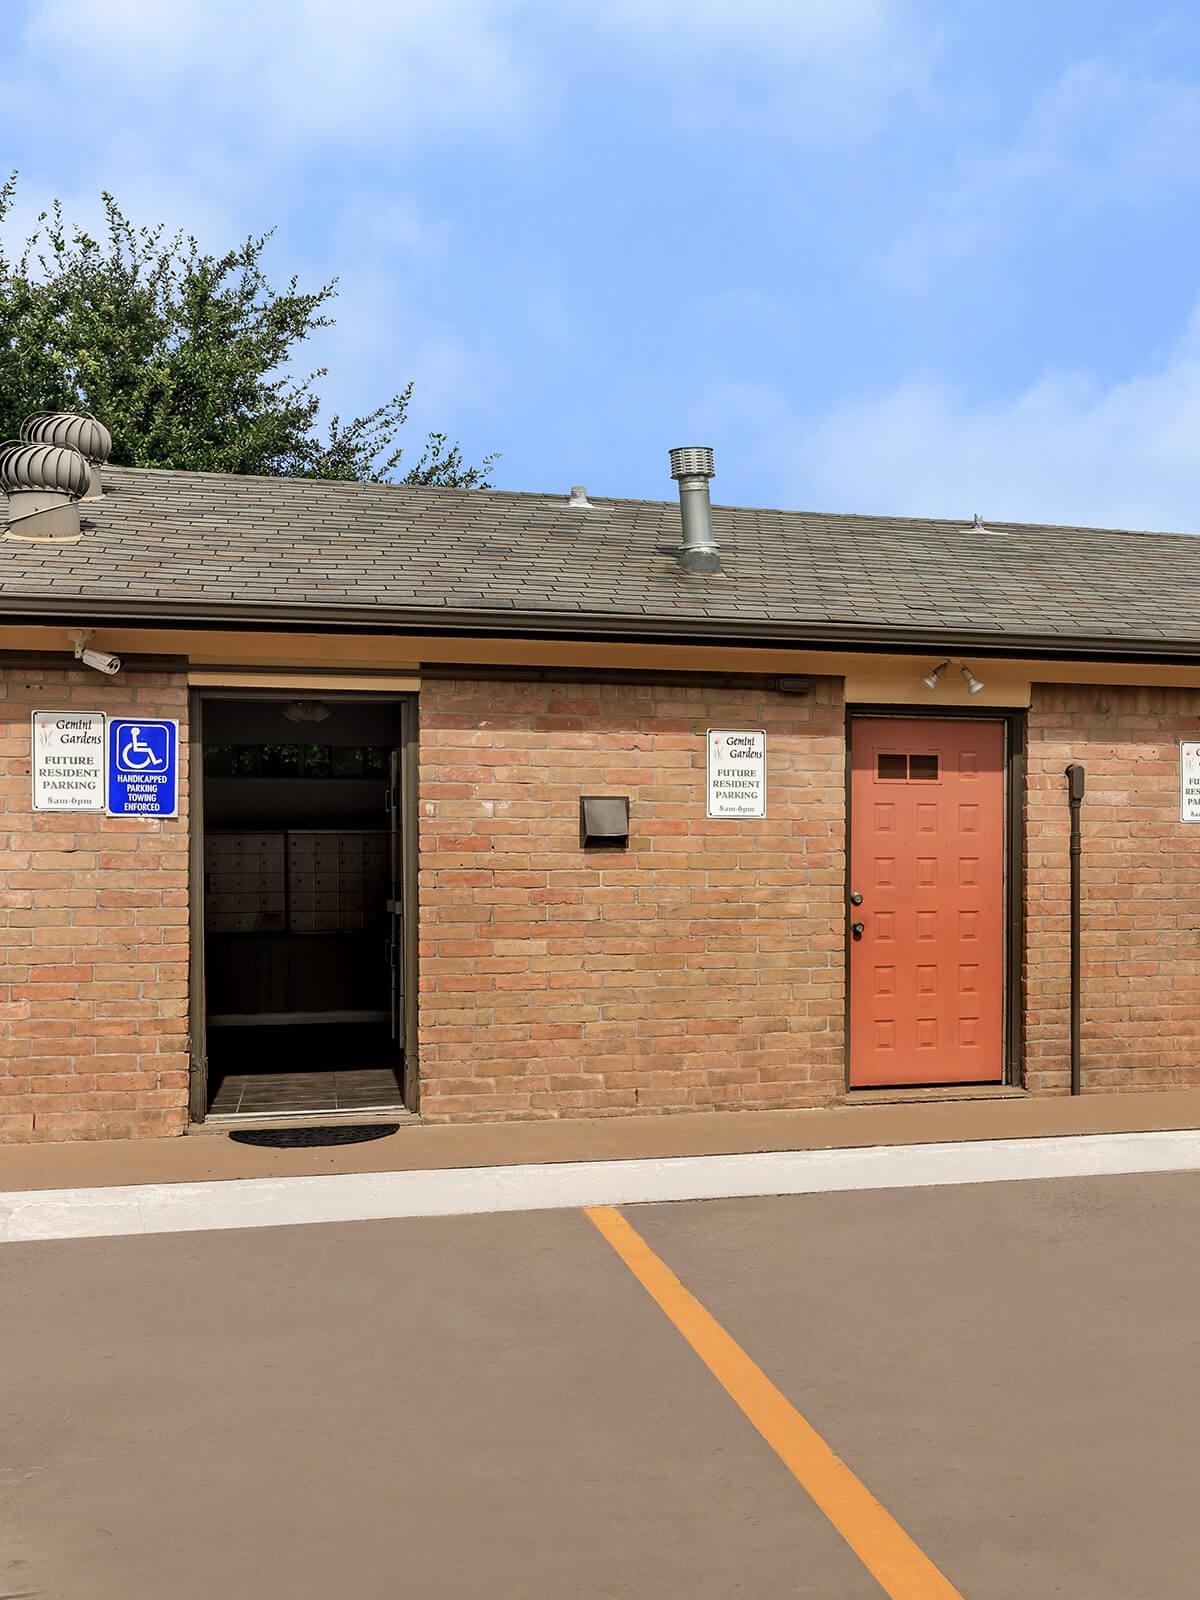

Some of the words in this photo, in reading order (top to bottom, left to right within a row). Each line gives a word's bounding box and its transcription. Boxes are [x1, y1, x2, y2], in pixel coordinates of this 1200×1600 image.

[56, 719, 92, 730] Gemini
[60, 731, 102, 745] Gardens
[726, 736, 755, 746] Gemini
[729, 747, 763, 759] Gardens
[44, 756, 95, 766] FUTURE
[39, 768, 100, 778] RESIDENT
[717, 769, 757, 778] FUTURE
[117, 774, 168, 784] HANDICAPPED
[42, 781, 97, 790] PARKING
[127, 784, 158, 793] PARKING
[712, 780, 761, 789] RESIDENT
[128, 793, 157, 802] TOWING
[715, 791, 758, 800] PARKING
[47, 796, 93, 805] 8am-6pm
[124, 803, 161, 812] ENFORCED
